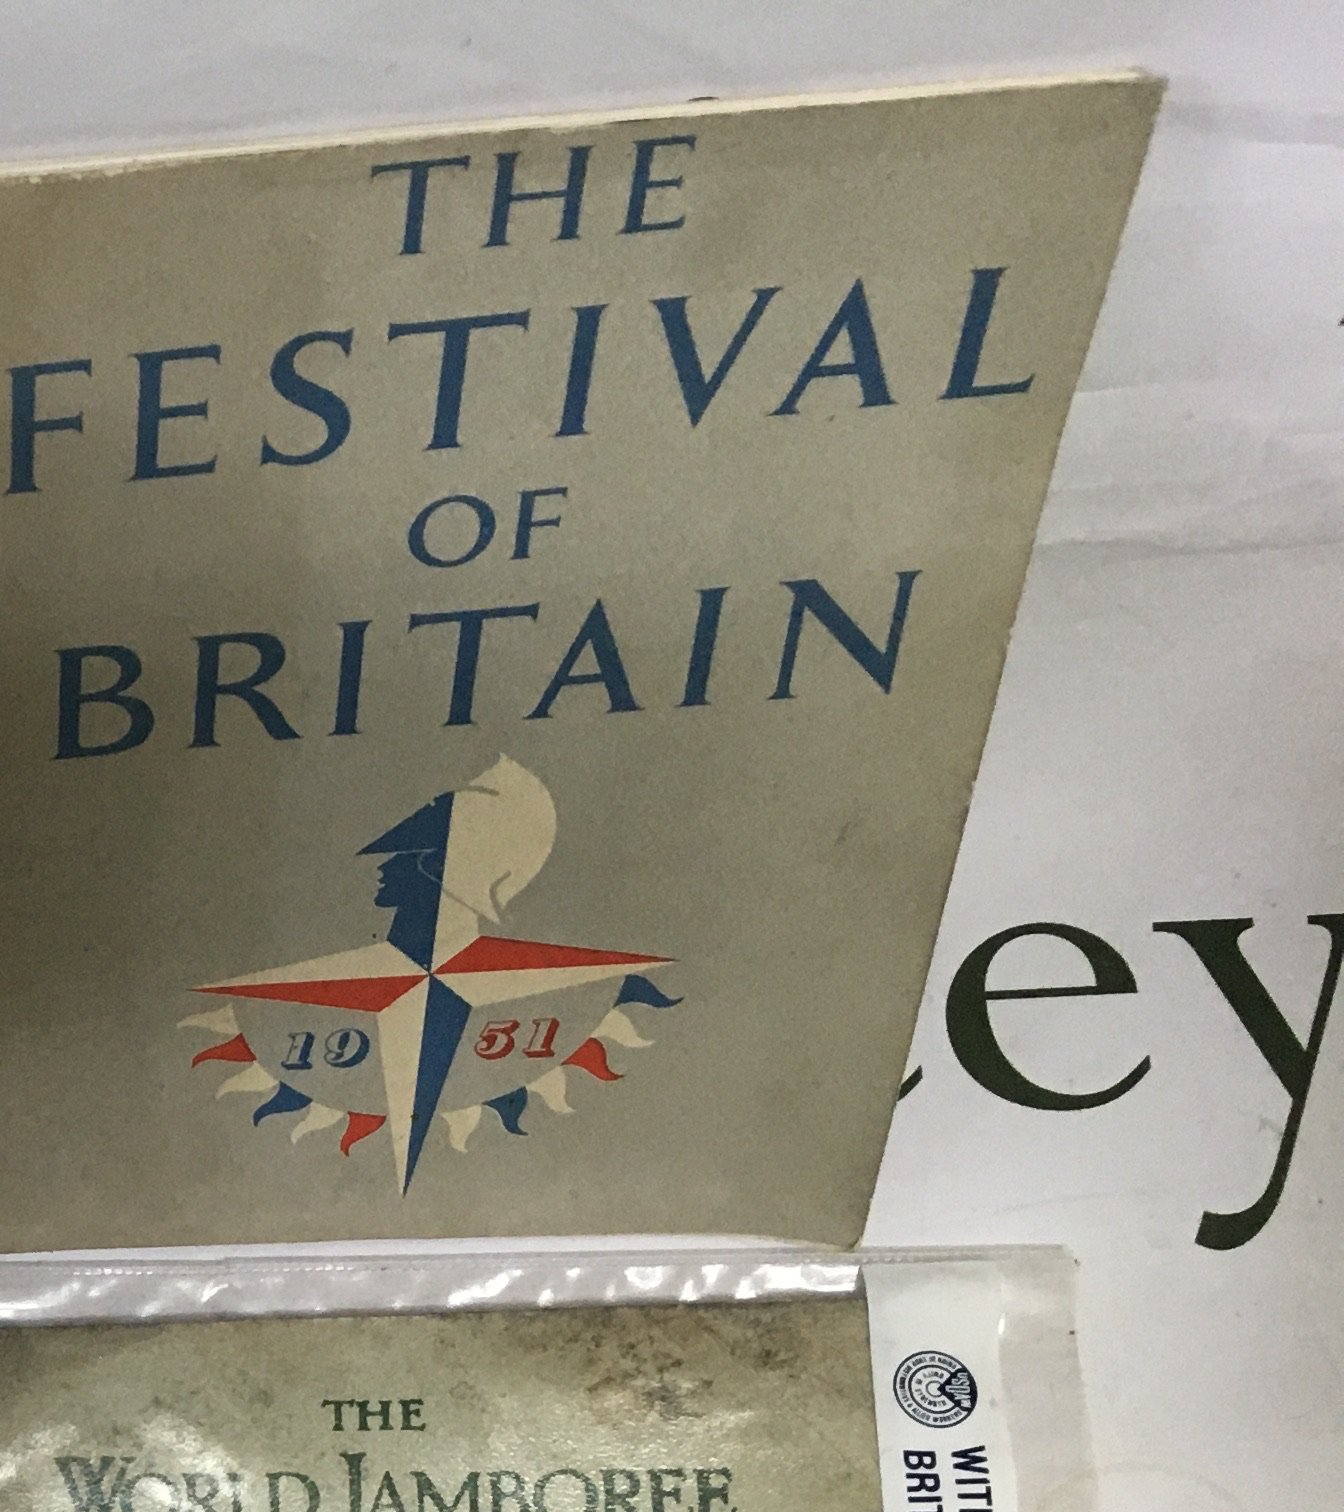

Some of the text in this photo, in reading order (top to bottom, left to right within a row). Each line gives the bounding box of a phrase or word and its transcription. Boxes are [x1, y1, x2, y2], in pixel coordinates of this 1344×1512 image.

[371, 135, 698, 255] THE
[4, 266, 1038, 496] FESTIVAL
[406, 486, 569, 568] OF
[51, 569, 924, 762] BRITAIN
[322, 1398, 427, 1432] THE
